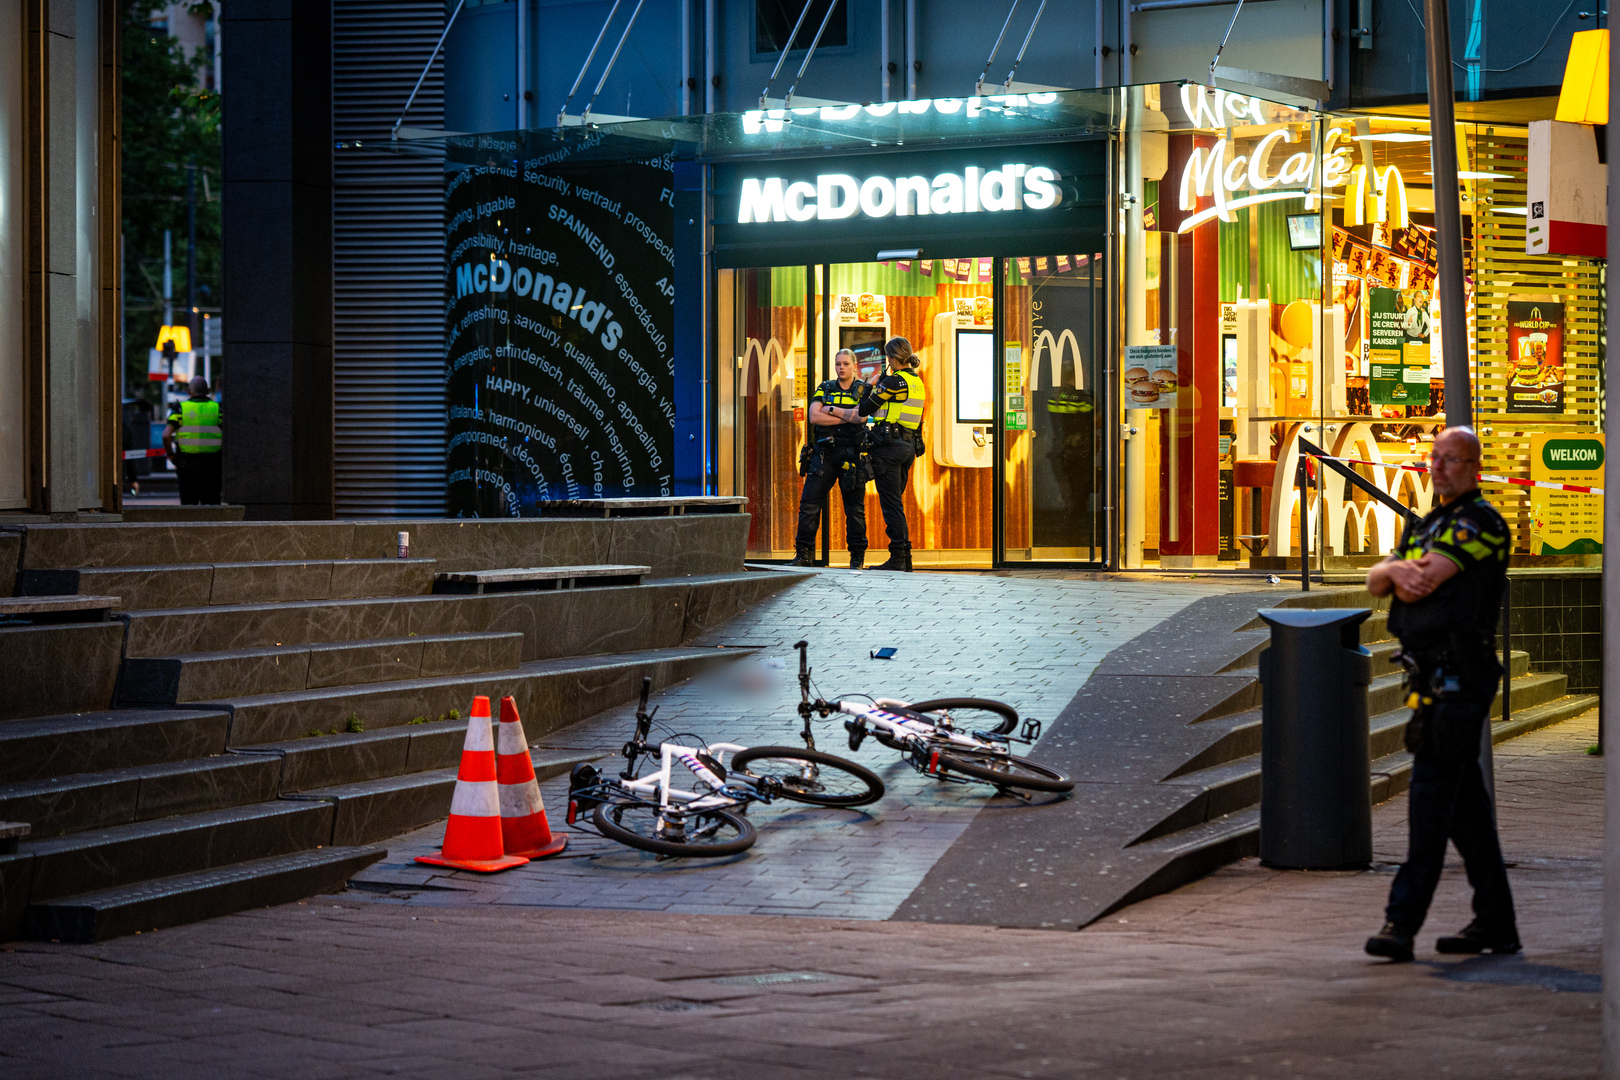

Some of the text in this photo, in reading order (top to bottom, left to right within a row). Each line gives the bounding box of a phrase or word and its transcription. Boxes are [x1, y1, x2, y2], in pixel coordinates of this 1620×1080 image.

[523, 170, 570, 197] security,
[575, 185, 621, 219] vertraut,
[738, 163, 1061, 223] McDonald's
[1179, 128, 1352, 223] McCafé
[476, 195, 516, 220] jugable
[509, 238, 559, 267] heritage,
[456, 259, 623, 350] McDonald's
[548, 204, 615, 275] SPANNEND,
[615, 273, 669, 359] espectáculo,
[1372, 320, 1381, 328] DE
[1372, 329, 1404, 337] SERVEREN
[1383, 312, 1407, 320] STUURT
[1372, 337, 1398, 346] KANSEN
[460, 304, 511, 330] refreshing,
[513, 313, 560, 348] savoury,
[563, 341, 615, 403] qualitativo,
[617, 400, 663, 472] appealing,
[486, 374, 531, 405] HAPPY,
[618, 348, 657, 399] energia,
[489, 408, 557, 454] harmonious,
[495, 343, 563, 387] erfinderisch,
[566, 377, 604, 426] träume,
[603, 420, 635, 493] inspiring,
[1549, 449, 1597, 461] WELKOM
